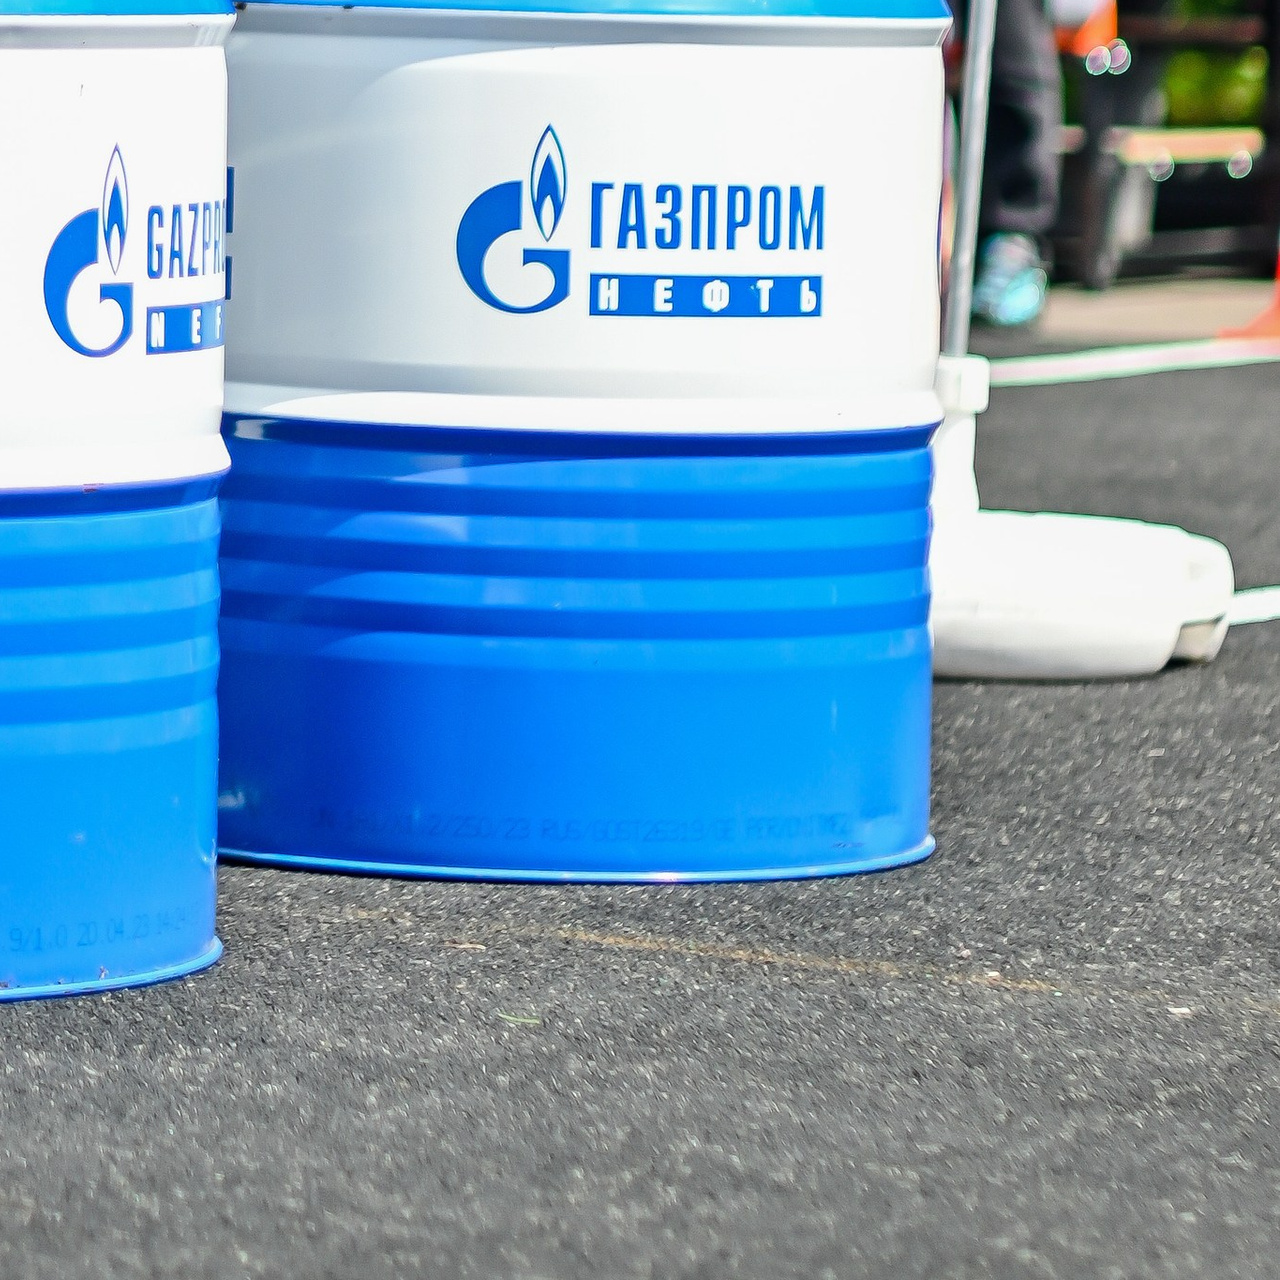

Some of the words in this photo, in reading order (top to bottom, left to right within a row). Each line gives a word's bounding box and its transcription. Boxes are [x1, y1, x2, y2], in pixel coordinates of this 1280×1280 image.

[147, 200, 224, 280] GAZPR
[591, 182, 825, 251] ГАЗПРОМ
[598, 279, 817, 313] НЕФТЬ
